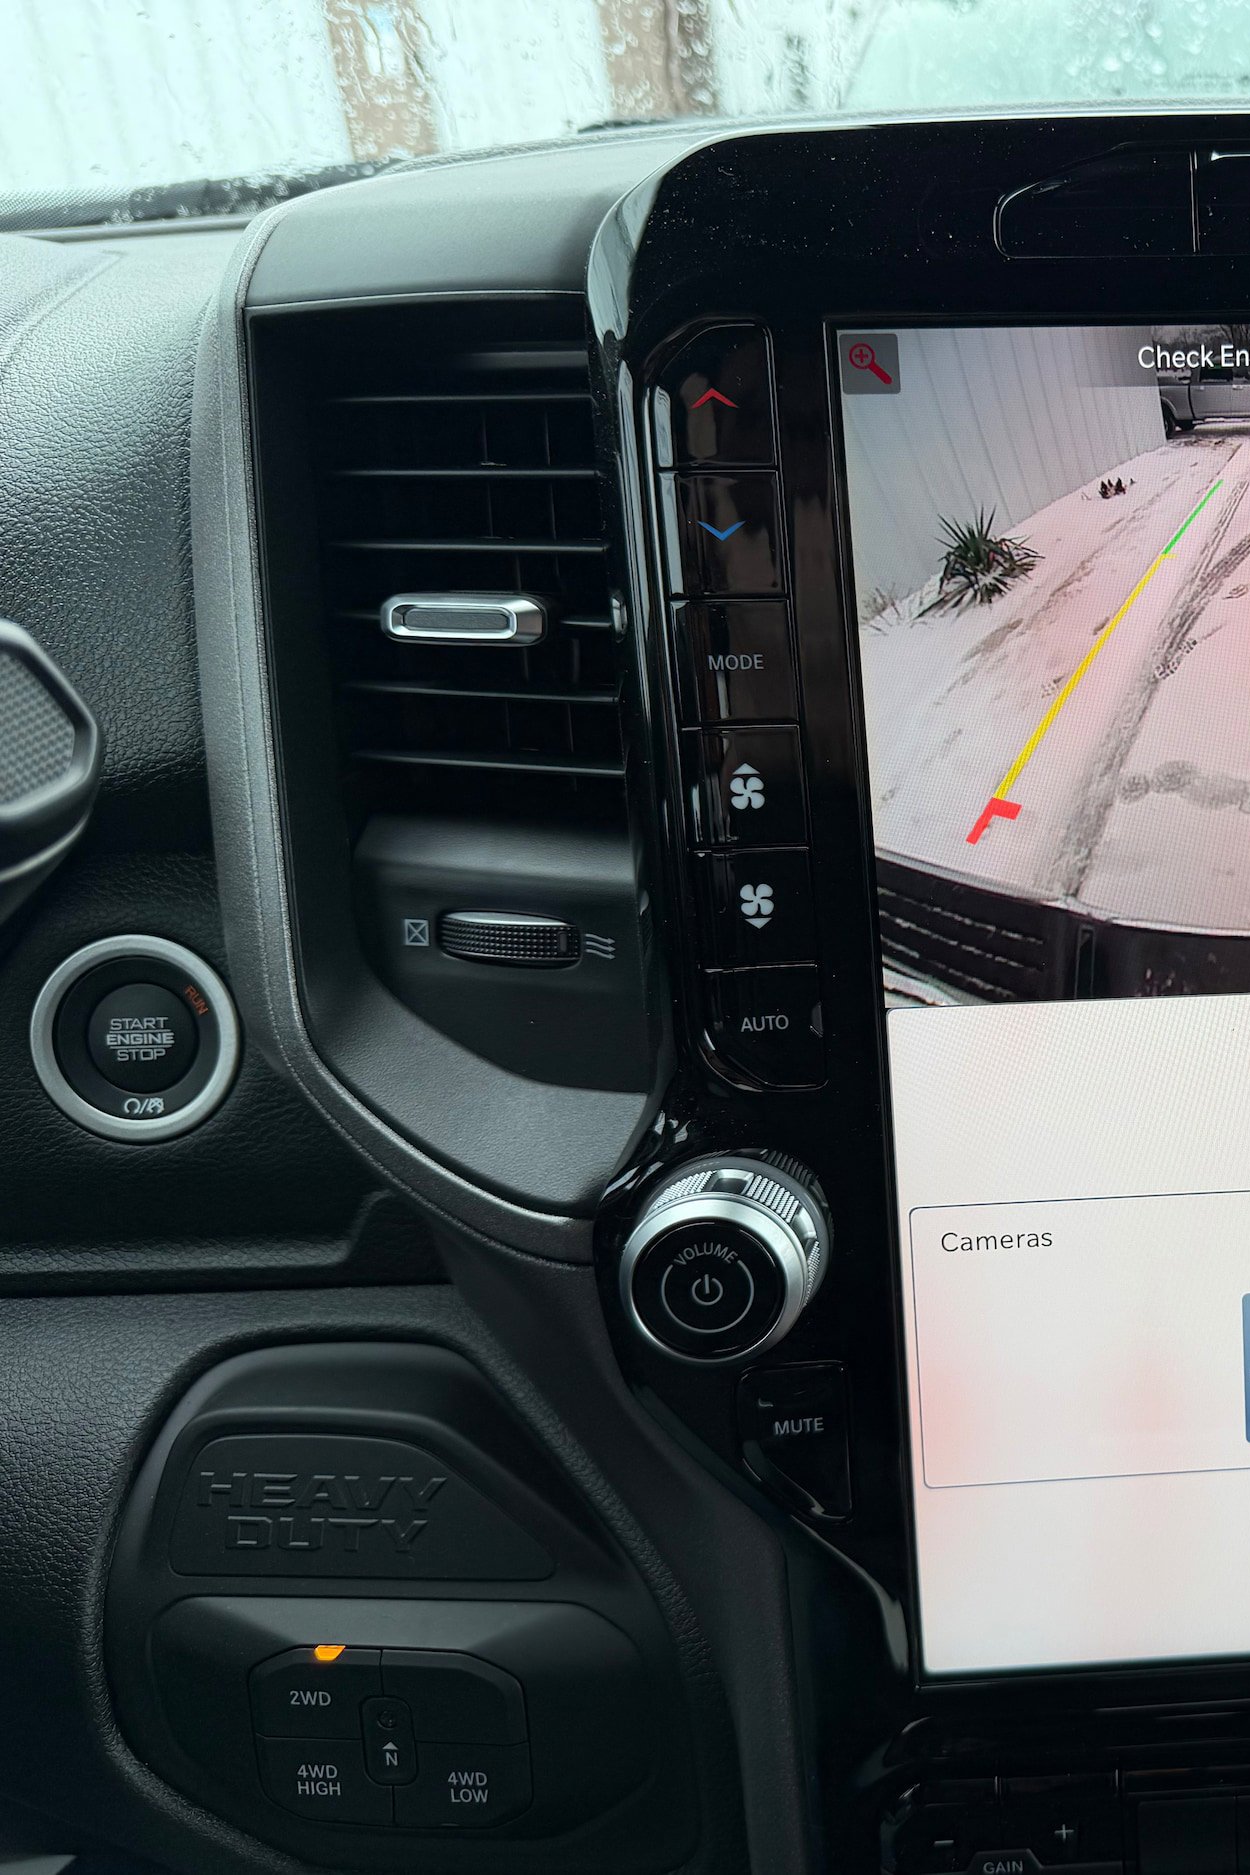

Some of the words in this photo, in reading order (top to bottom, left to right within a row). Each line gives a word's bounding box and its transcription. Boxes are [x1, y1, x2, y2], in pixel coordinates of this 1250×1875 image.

[1137, 345, 1214, 369] Check
[708, 654, 765, 671] MODE
[184, 984, 209, 1016] RUN
[110, 1016, 168, 1031] START
[740, 1014, 789, 1032] AUTO
[106, 1032, 175, 1046] ENGINE
[117, 1049, 166, 1062] STOP
[940, 1229, 1053, 1253] Cameras
[673, 1242, 739, 1267] VOLUME
[774, 1417, 825, 1436] MUTE
[197, 1471, 447, 1511] HEAVY
[224, 1515, 428, 1552] DUTY
[289, 1690, 332, 1707] 2WD
[385, 1751, 398, 1767] N
[297, 1764, 338, 1780] 4WD
[447, 1771, 488, 1787] 4WD
[297, 1780, 342, 1797] HIGH
[450, 1788, 489, 1804] LOW
[982, 1859, 1024, 1875] GAIN
